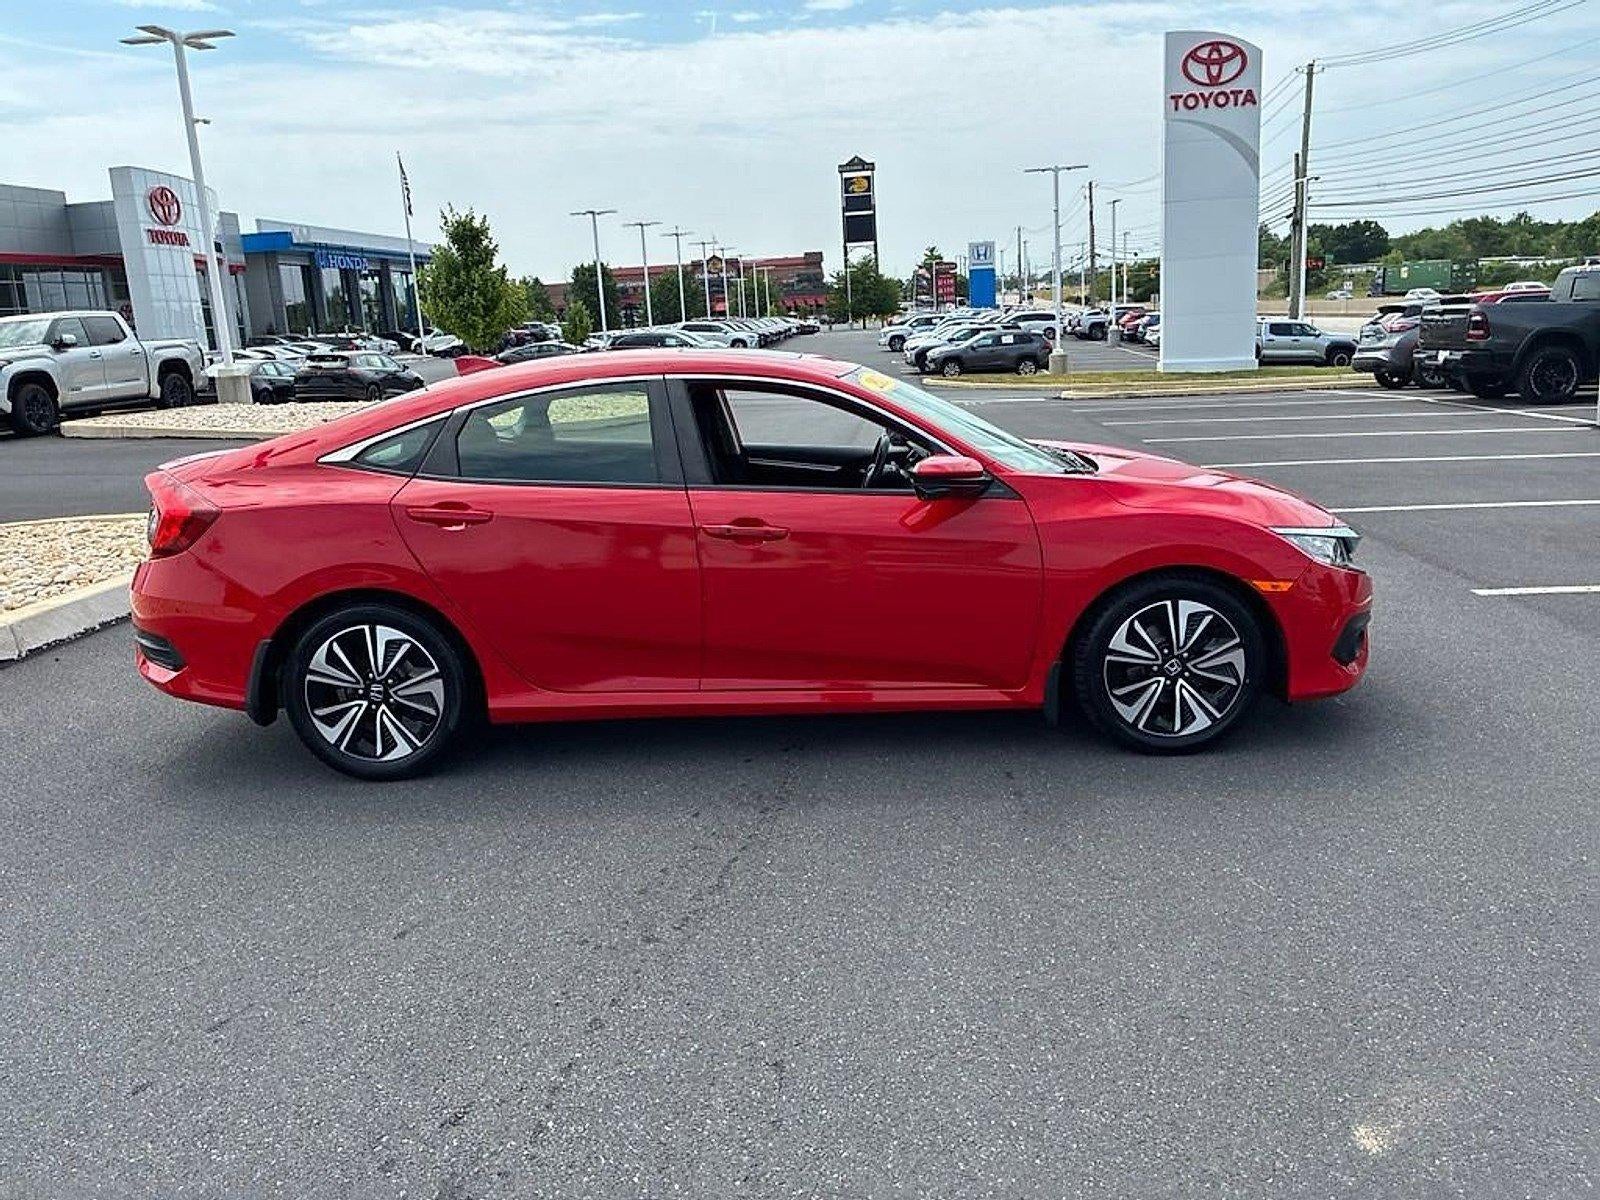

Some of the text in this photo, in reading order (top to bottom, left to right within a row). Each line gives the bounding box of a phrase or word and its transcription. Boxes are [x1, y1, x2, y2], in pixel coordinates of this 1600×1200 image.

[1170, 89, 1257, 111] TOYOTA
[147, 229, 190, 247] TOYOTA
[328, 254, 369, 270] HONDA
